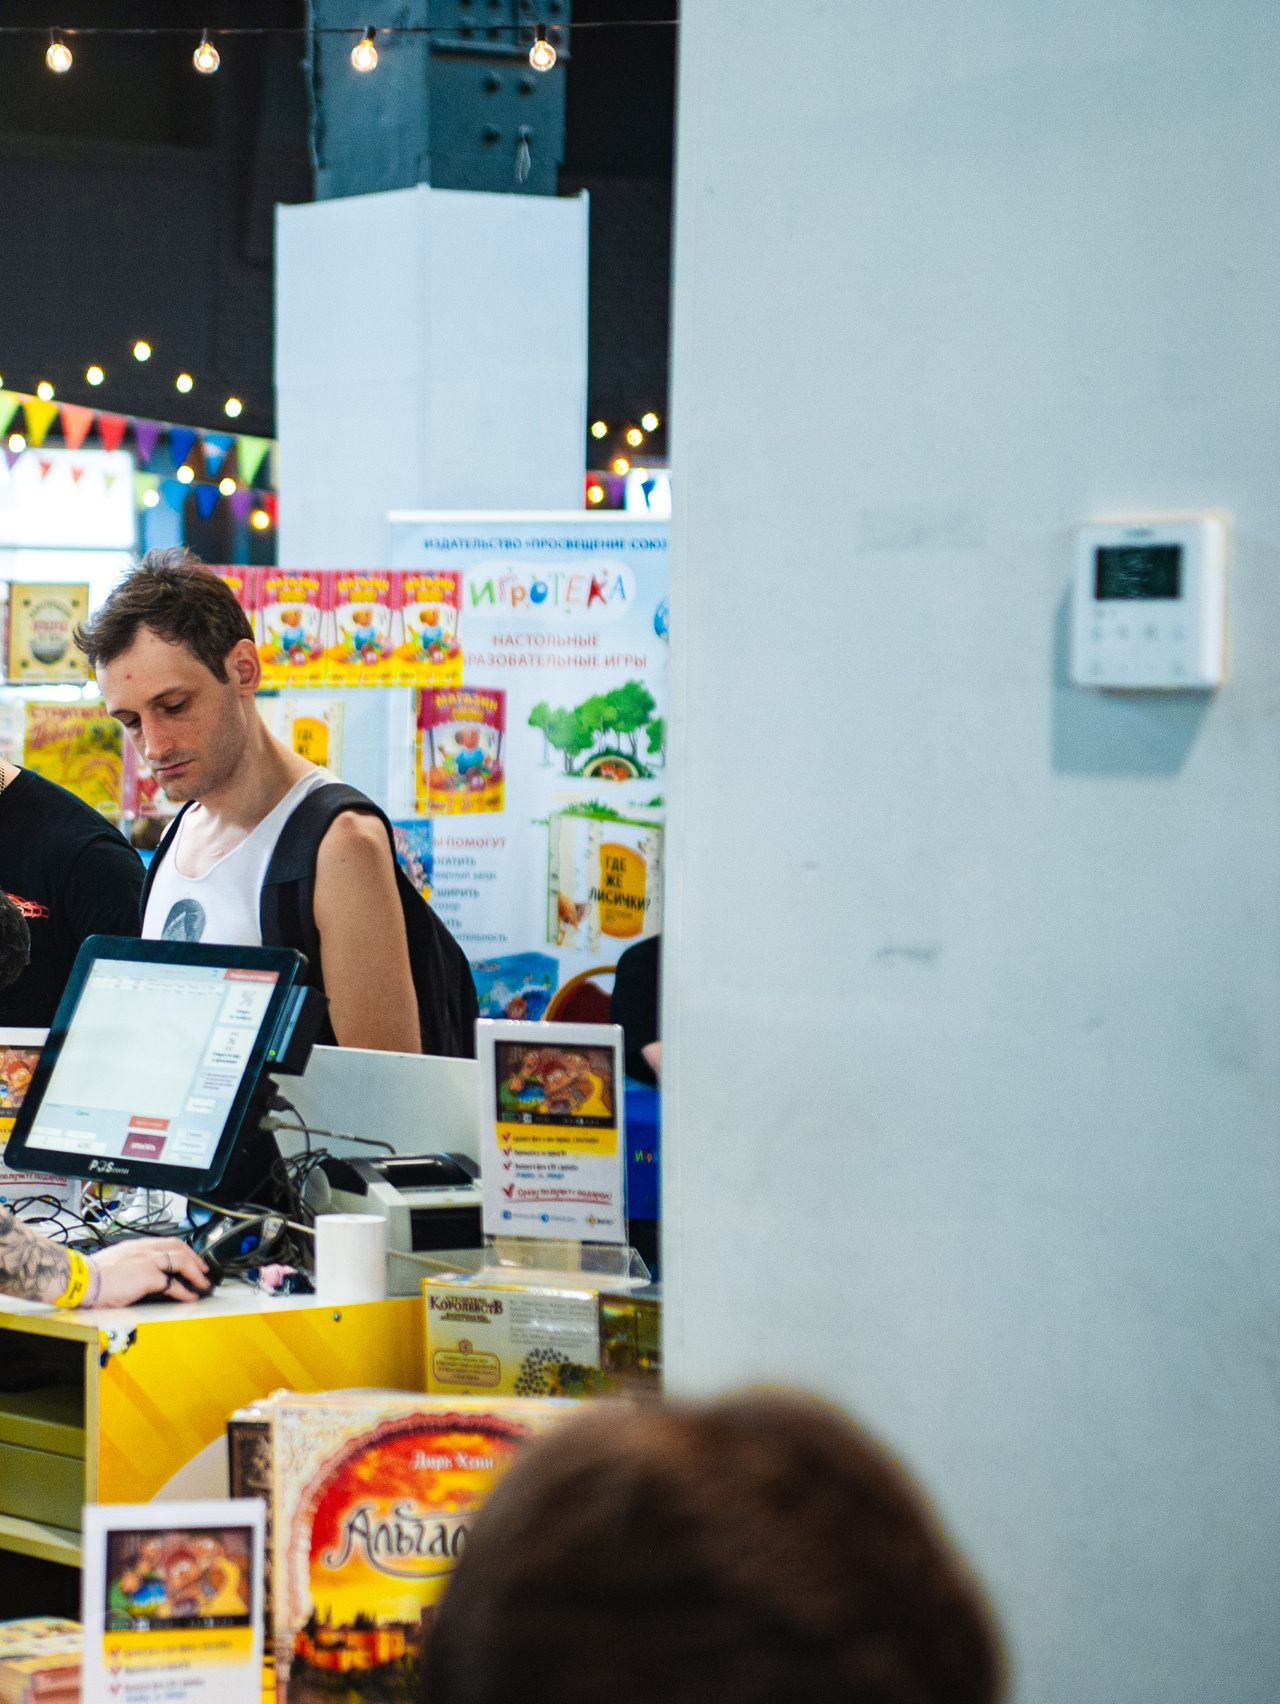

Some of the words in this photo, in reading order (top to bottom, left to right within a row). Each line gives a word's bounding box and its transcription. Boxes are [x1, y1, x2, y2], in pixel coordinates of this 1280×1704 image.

[424, 537, 522, 550] ИЗДАТЕЛЬСТВО
[492, 633, 600, 647] НАСТОЛЬНЫЕ
[463, 654, 599, 668] РАЗОВАТЕЛЬНЫЕ
[604, 654, 647, 668] ИГРЫ
